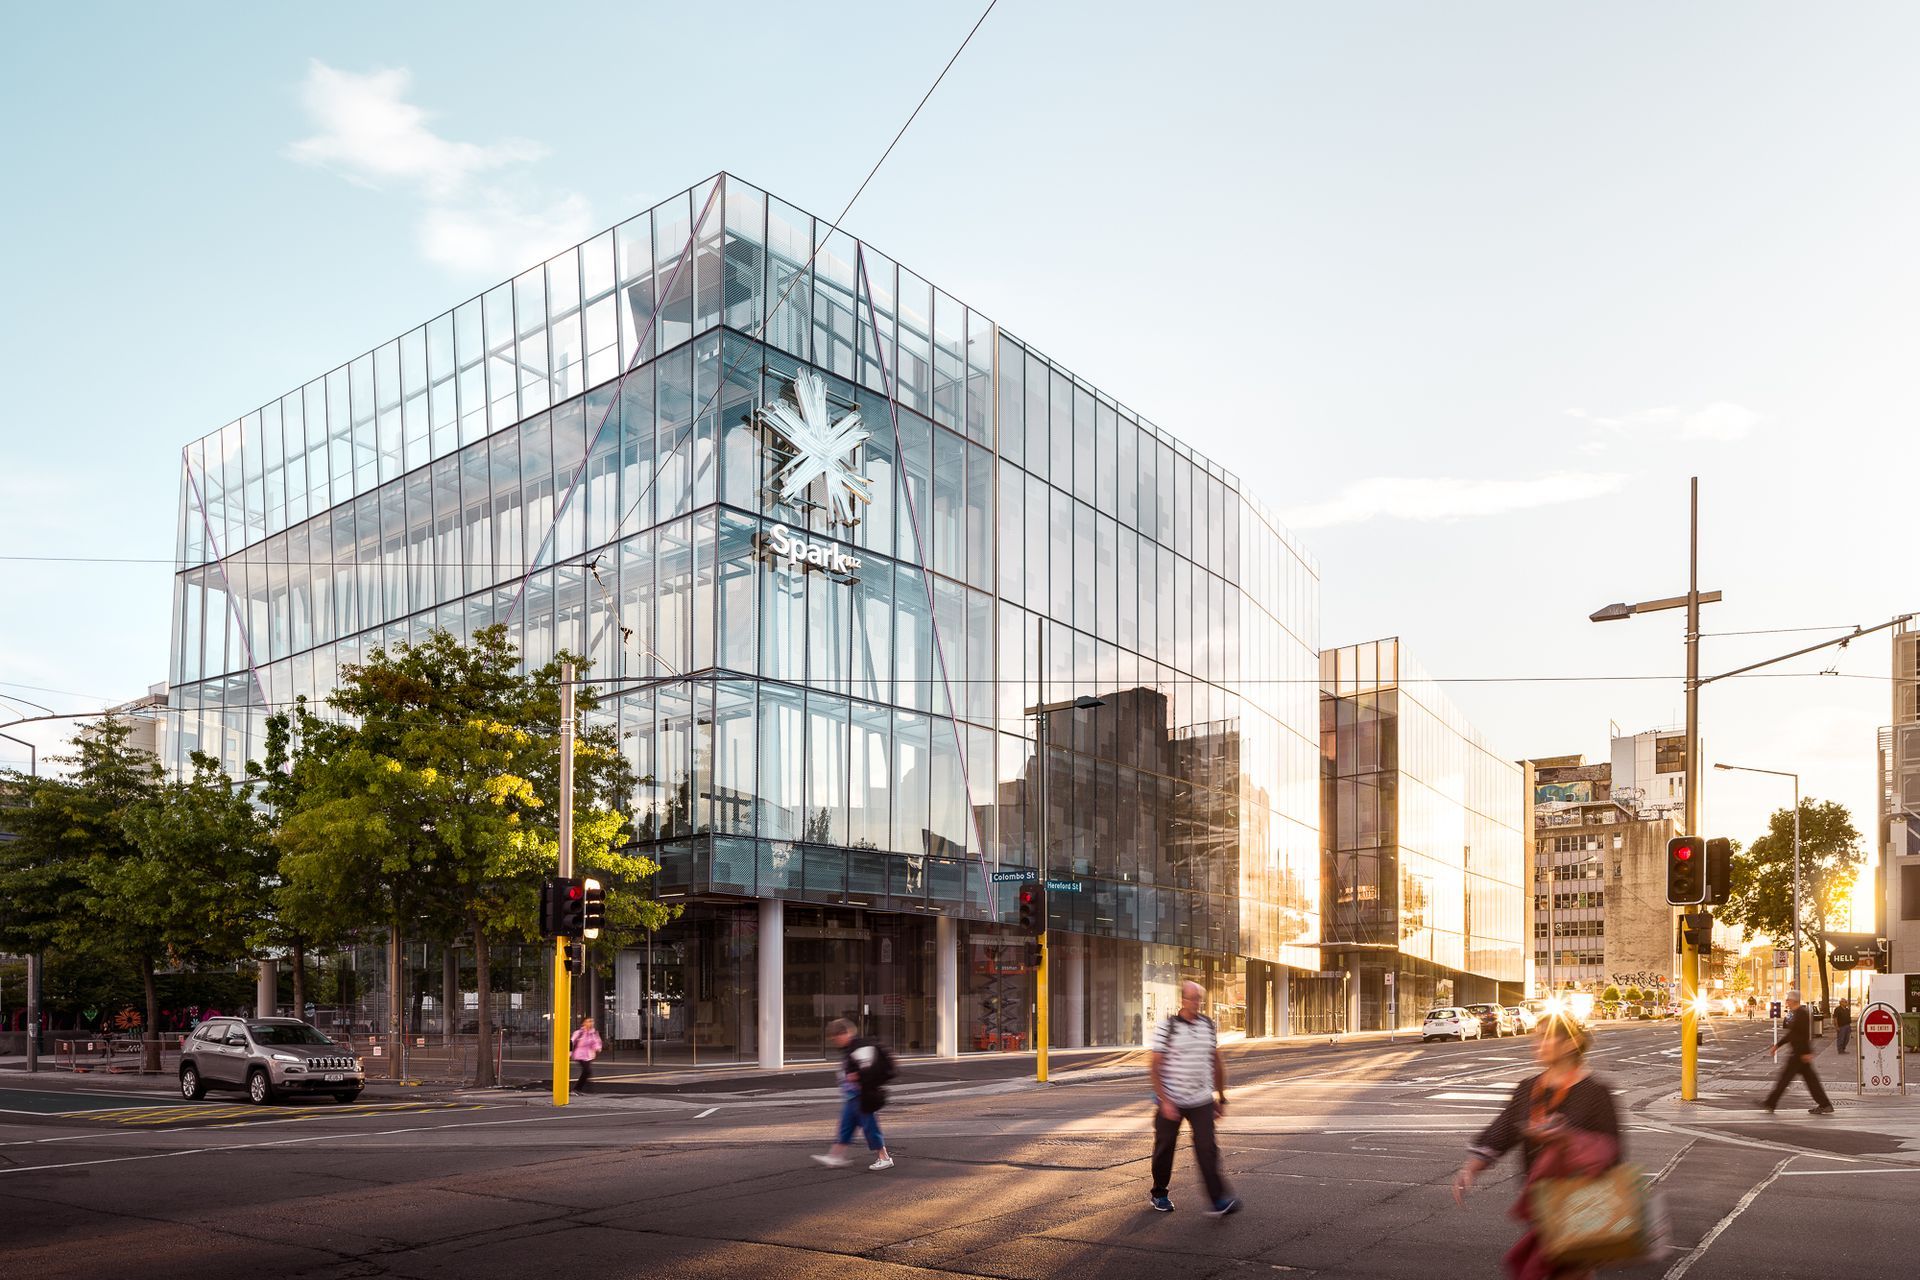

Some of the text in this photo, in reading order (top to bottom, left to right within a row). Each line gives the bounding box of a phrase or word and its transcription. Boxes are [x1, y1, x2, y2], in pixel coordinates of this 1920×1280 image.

[769, 523, 849, 574] Spark
[993, 871, 1035, 881] Colombo St
[1047, 881, 1079, 890] Hereford St
[1833, 954, 1854, 962] HELL
